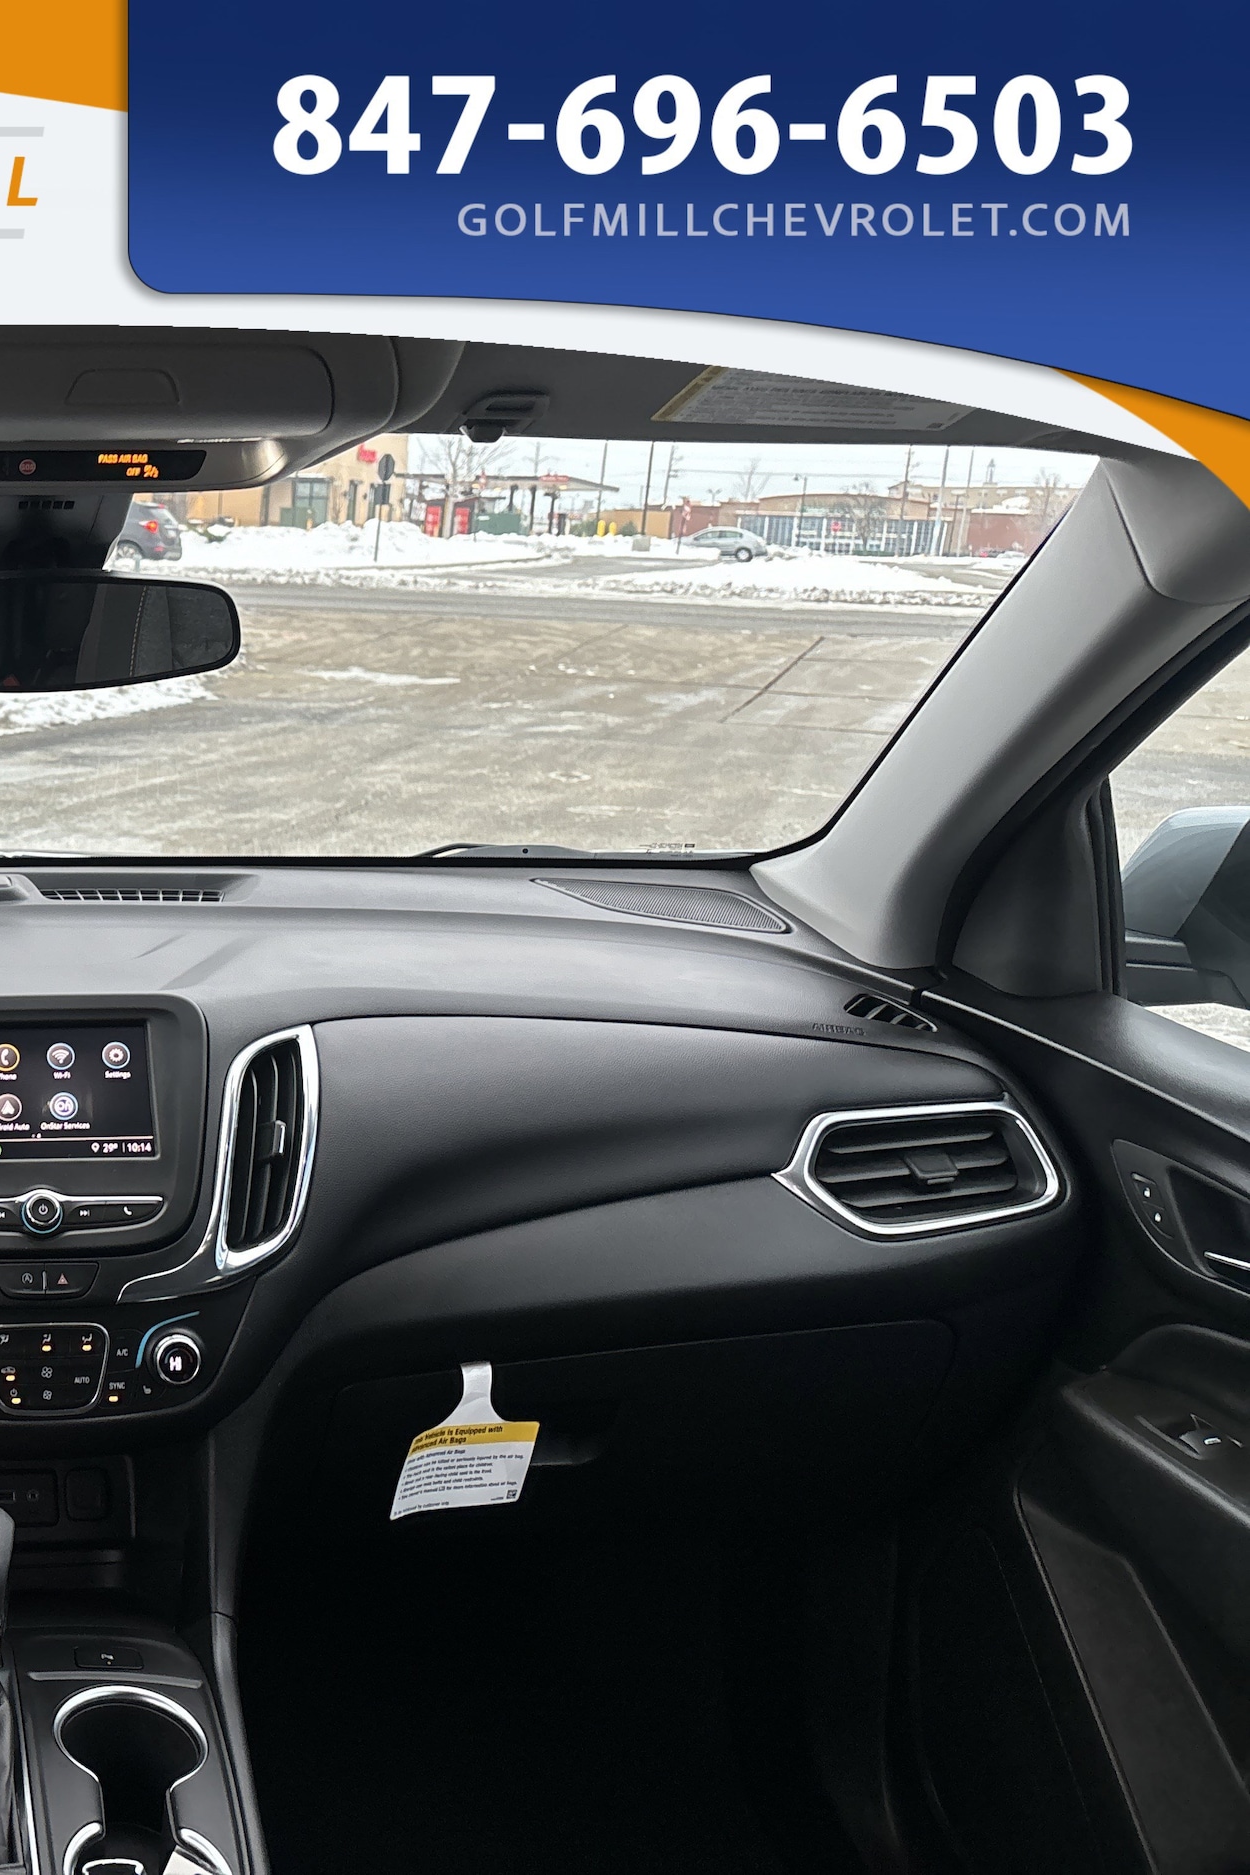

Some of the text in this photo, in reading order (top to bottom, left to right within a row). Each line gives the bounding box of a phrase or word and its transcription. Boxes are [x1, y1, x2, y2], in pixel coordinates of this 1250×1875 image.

[127, 1143, 152, 1152] 10:14
[116, 1349, 129, 1357] A/C
[169, 1356, 182, 1371] HI
[109, 1382, 126, 1390] SYNC
[455, 1427, 487, 1438] Equipped
[488, 1425, 503, 1433] with
